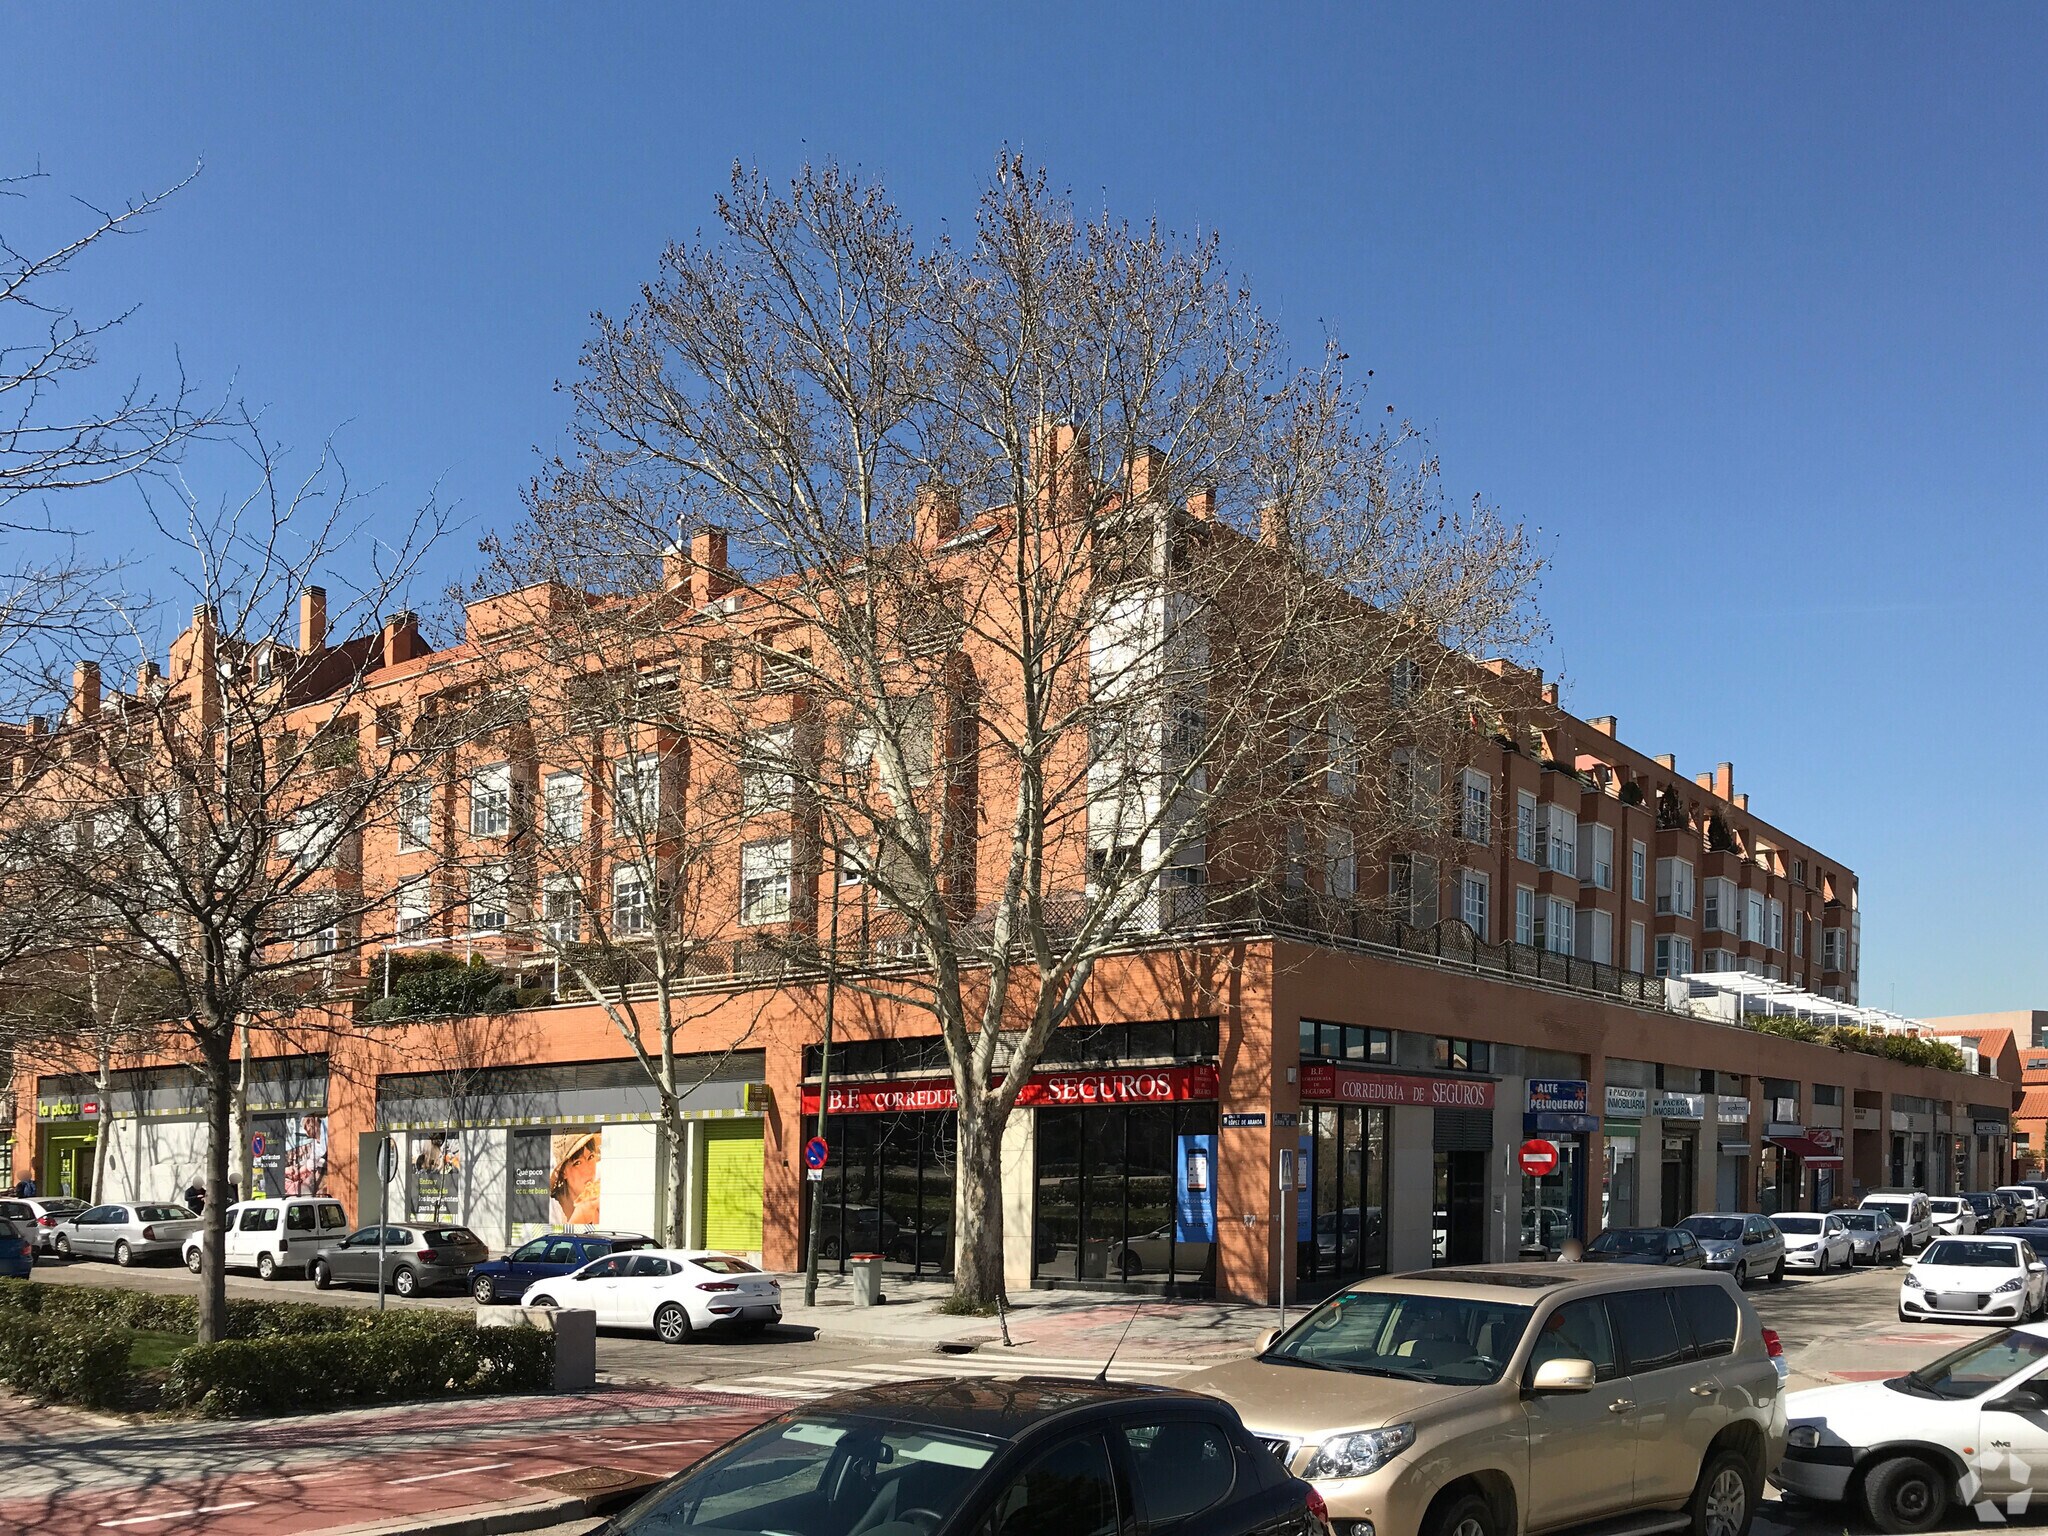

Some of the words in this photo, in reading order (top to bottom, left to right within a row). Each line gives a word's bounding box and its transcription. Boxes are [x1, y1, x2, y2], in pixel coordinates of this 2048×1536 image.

[875, 1089, 958, 1108] CORREDUR
[1048, 1073, 1171, 1100] SEGUROS
[1342, 1081, 1404, 1100] CORREDURÍA
[1413, 1087, 1425, 1102] DE
[1432, 1083, 1485, 1105] SEGUROS
[1537, 1083, 1559, 1093] ALTE
[1613, 1089, 1637, 1098] PACEGO
[1530, 1099, 1585, 1110] PELUQUEROS
[1607, 1098, 1646, 1109] INMOBILIARIA
[39, 1100, 49, 1116] la
[51, 1099, 80, 1120] plaza
[1652, 1107, 1691, 1116] INMOBILIARIA
[516, 1168, 528, 1177] Qué
[529, 1169, 543, 1177] poco
[535, 1187, 549, 1195] bien
